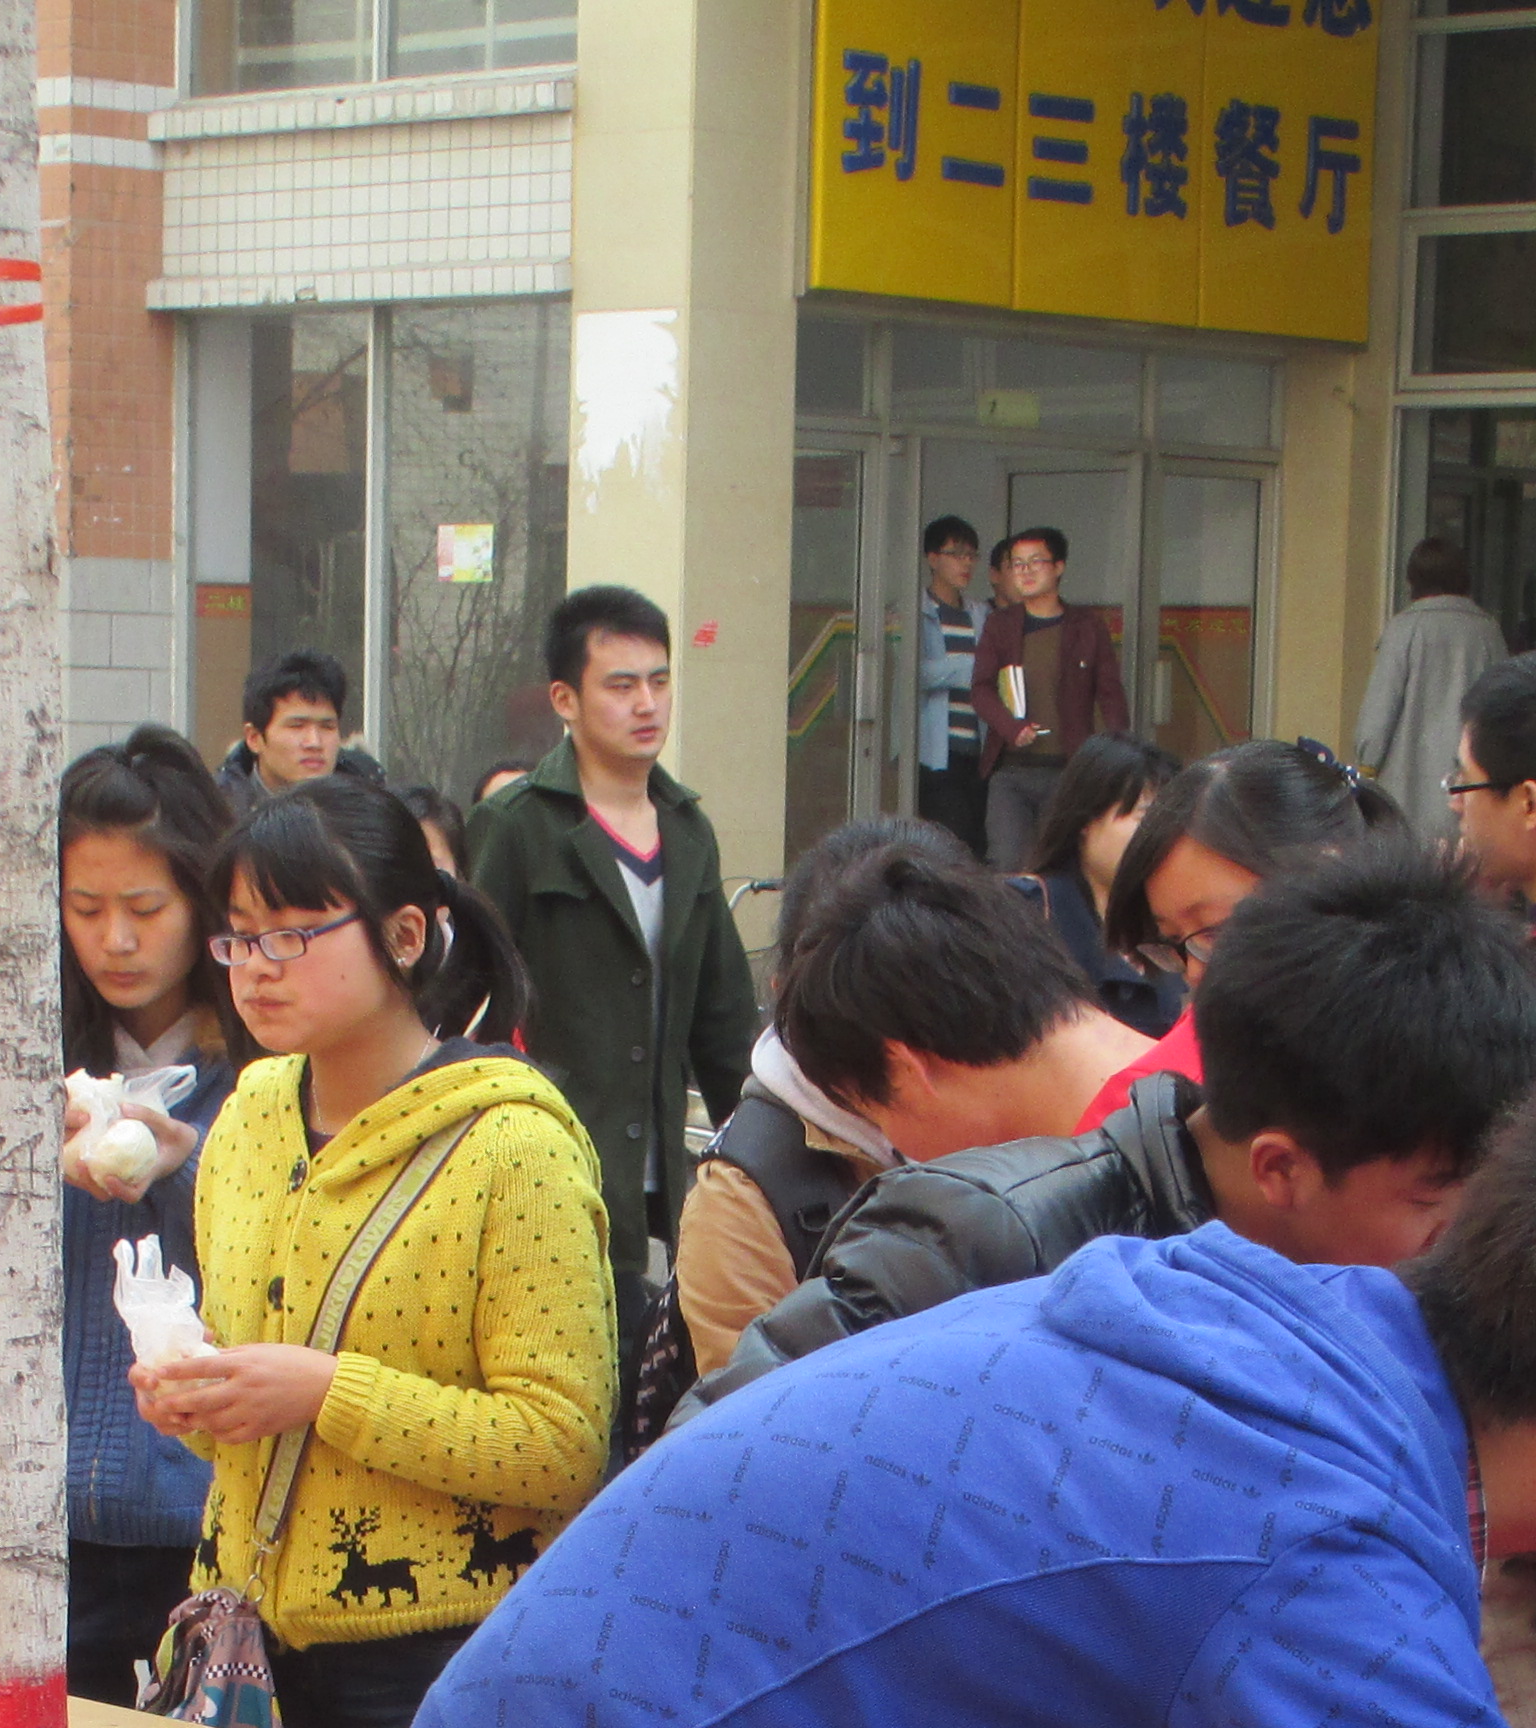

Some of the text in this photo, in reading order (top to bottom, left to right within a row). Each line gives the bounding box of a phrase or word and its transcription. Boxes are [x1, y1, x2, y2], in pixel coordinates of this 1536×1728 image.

[841, 48, 1361, 234] 到二三楼餐厅
[898, 1375, 938, 1392] adidas
[994, 1403, 1035, 1426] adidas
[770, 1433, 810, 1449] adidas
[1088, 1434, 1133, 1459] adidas
[865, 1454, 907, 1479] adidas
[1192, 1468, 1237, 1492] adidas
[830, 1470, 848, 1516] adidas
[964, 1492, 1006, 1517] adidas
[654, 1504, 691, 1521] adidas
[1295, 1499, 1338, 1523] adidas
[746, 1522, 786, 1545] adidas
[929, 1504, 945, 1549] adidas
[714, 1540, 730, 1584] adidas
[841, 1551, 883, 1577] adidas
[811, 1565, 826, 1609] adidas
[630, 1593, 672, 1614] adidas
[597, 1613, 614, 1652] adidas
[726, 1619, 768, 1644] adidas
[695, 1634, 711, 1678] adidas
[609, 1688, 651, 1711] adidas
